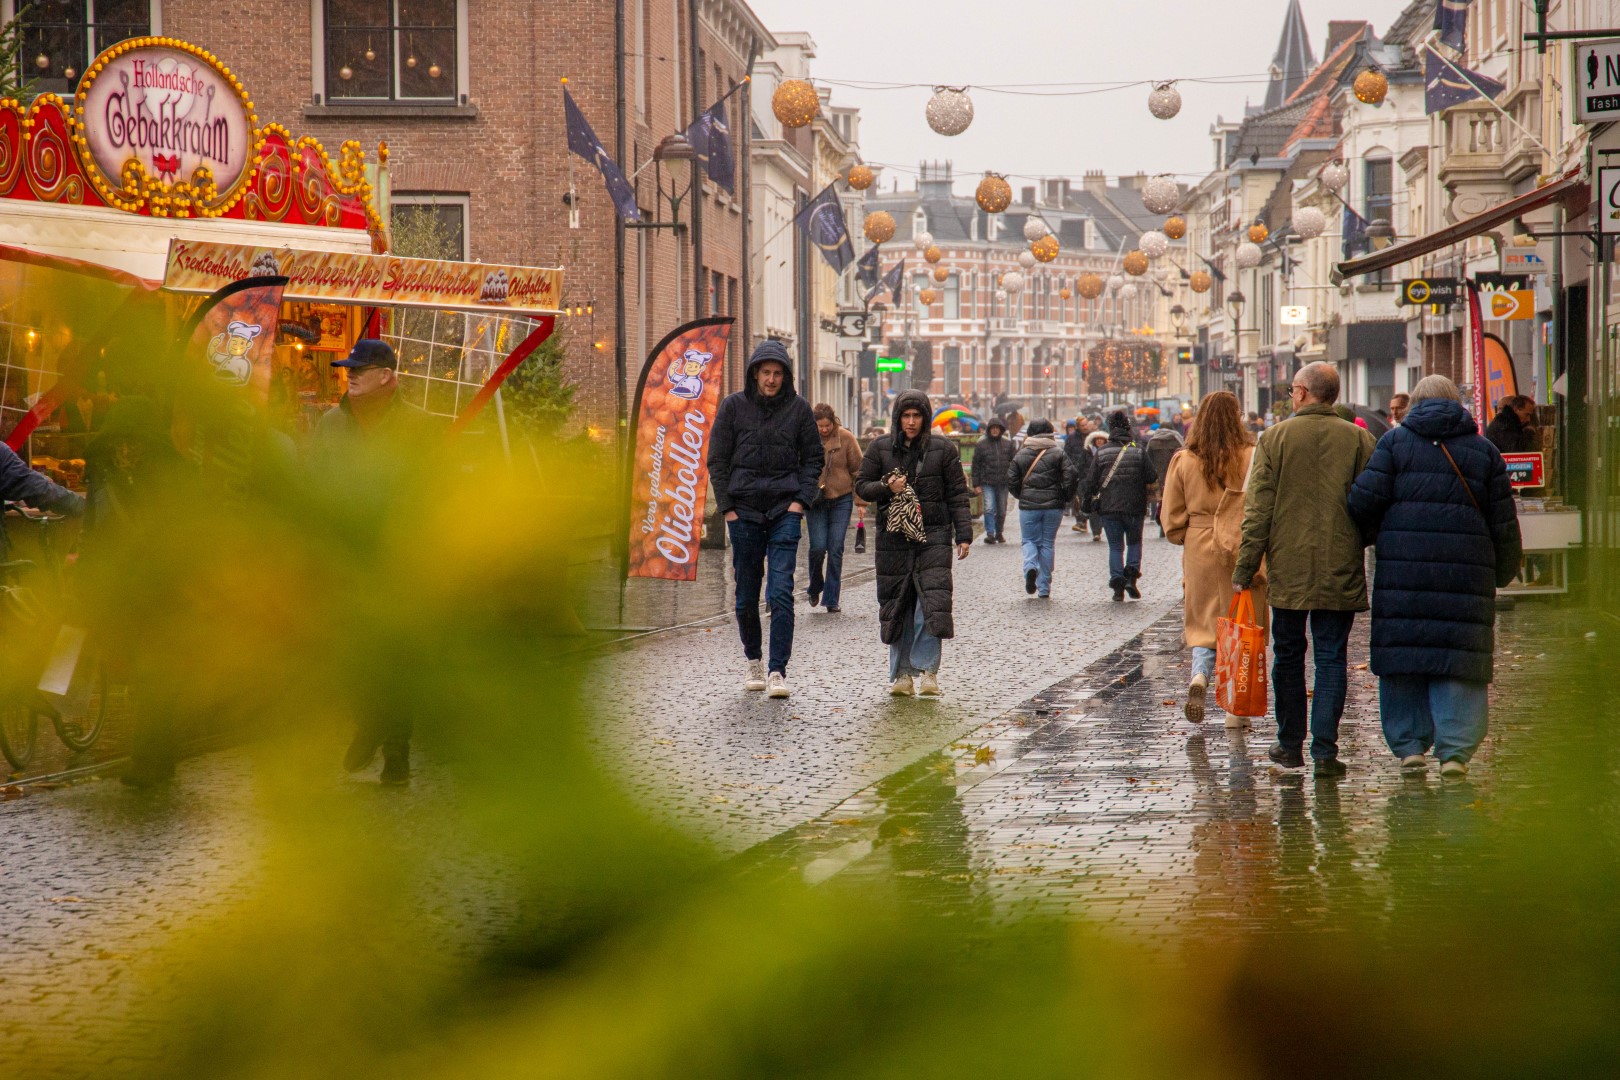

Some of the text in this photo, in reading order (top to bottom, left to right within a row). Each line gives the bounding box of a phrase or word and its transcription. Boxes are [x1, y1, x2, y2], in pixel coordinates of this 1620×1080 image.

[132, 59, 205, 97] Hollandsche
[106, 92, 229, 165] Gebakkraam
[173, 244, 250, 281] Krentenbollen
[508, 275, 551, 297] Oliebollen
[1430, 285, 1452, 295] wish
[642, 425, 665, 534] Vers gebakken
[656, 409, 706, 564] Oliebollen
[1237, 641, 1251, 692] blokker.nl
